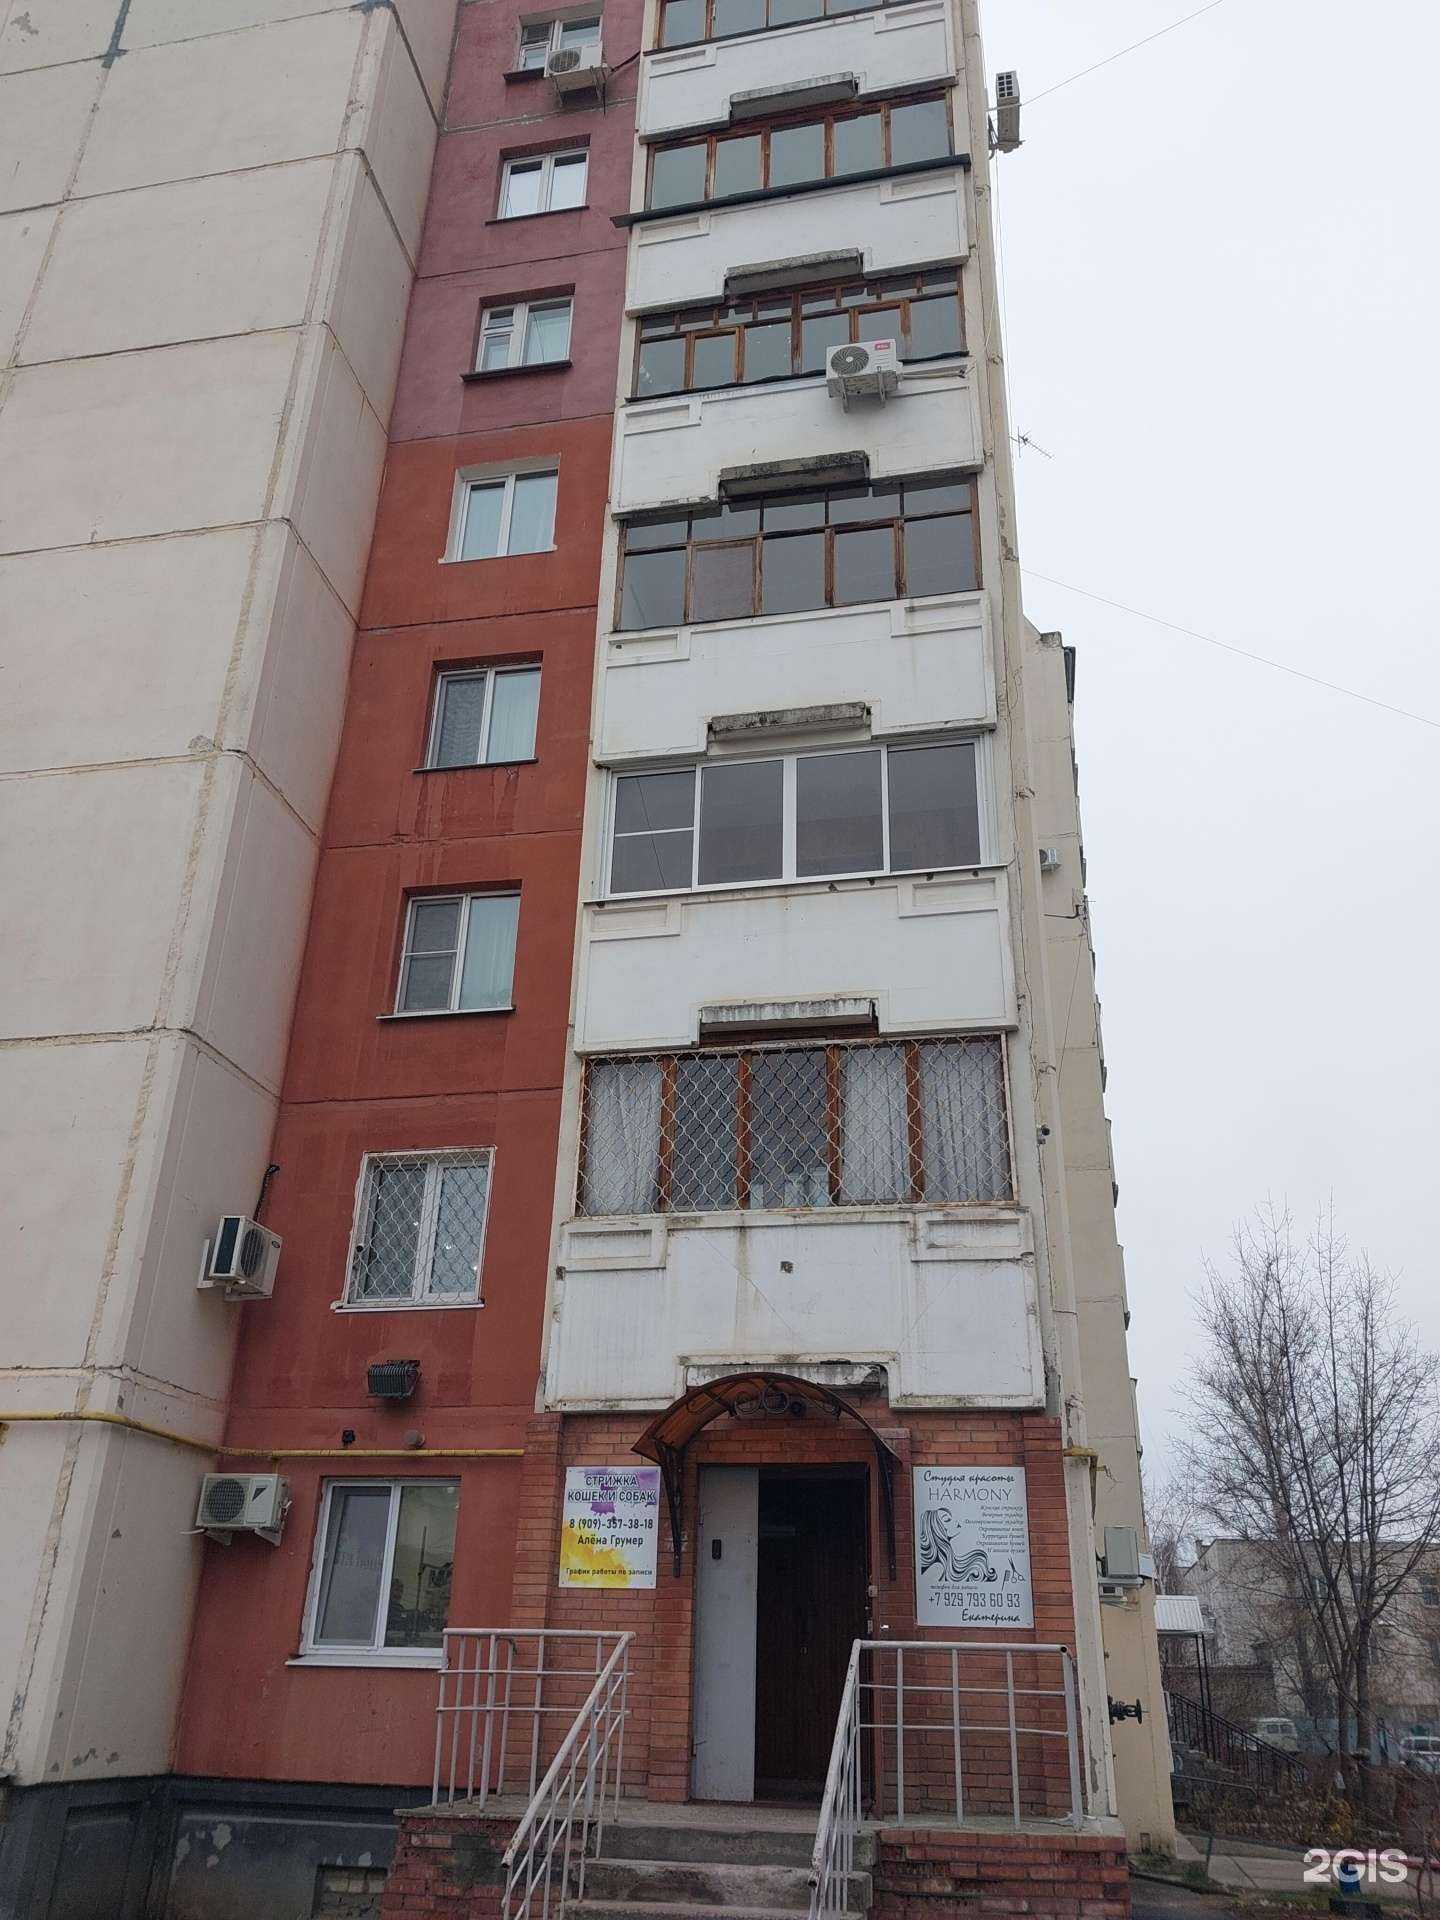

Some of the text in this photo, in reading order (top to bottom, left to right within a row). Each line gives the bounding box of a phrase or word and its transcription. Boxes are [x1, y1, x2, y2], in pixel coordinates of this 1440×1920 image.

[585, 1475, 637, 1486] СТРИЖКА
[923, 1470, 1015, 1486] Студия красоты
[567, 1491, 653, 1502] КОШЕК И СОБАК
[928, 1487, 1012, 1501] HARMONY
[569, 1518, 653, 1530] 8 (909)-357-38-18
[577, 1534, 643, 1547] Алёна Грумер
[566, 1567, 653, 1577] График работы по записи
[928, 1592, 1020, 1608] +7 929 793 60 93
[961, 1608, 1021, 1625] Екатерина
